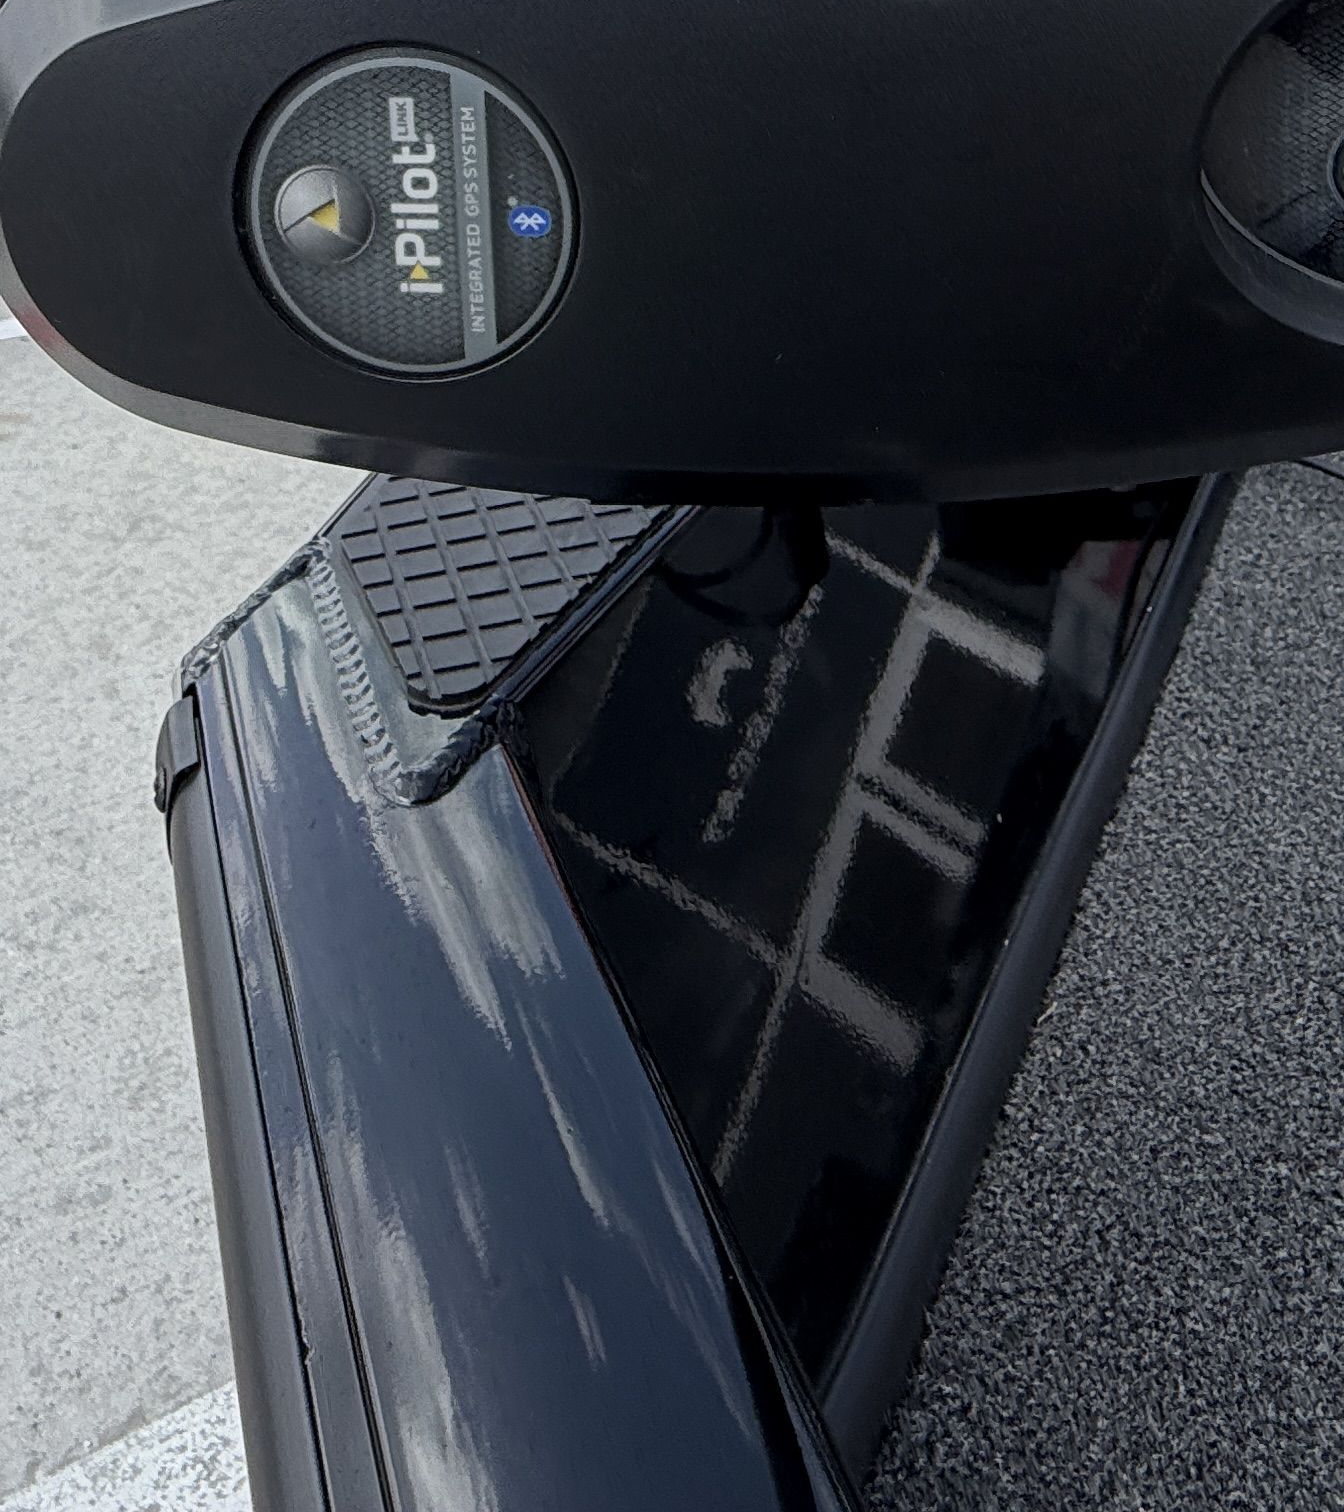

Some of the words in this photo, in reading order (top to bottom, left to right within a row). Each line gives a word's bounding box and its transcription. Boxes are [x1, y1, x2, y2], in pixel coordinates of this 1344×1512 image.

[460, 106, 477, 179] SYSTEM
[465, 181, 480, 217] GPS
[467, 223, 485, 334] INTEGRATED
